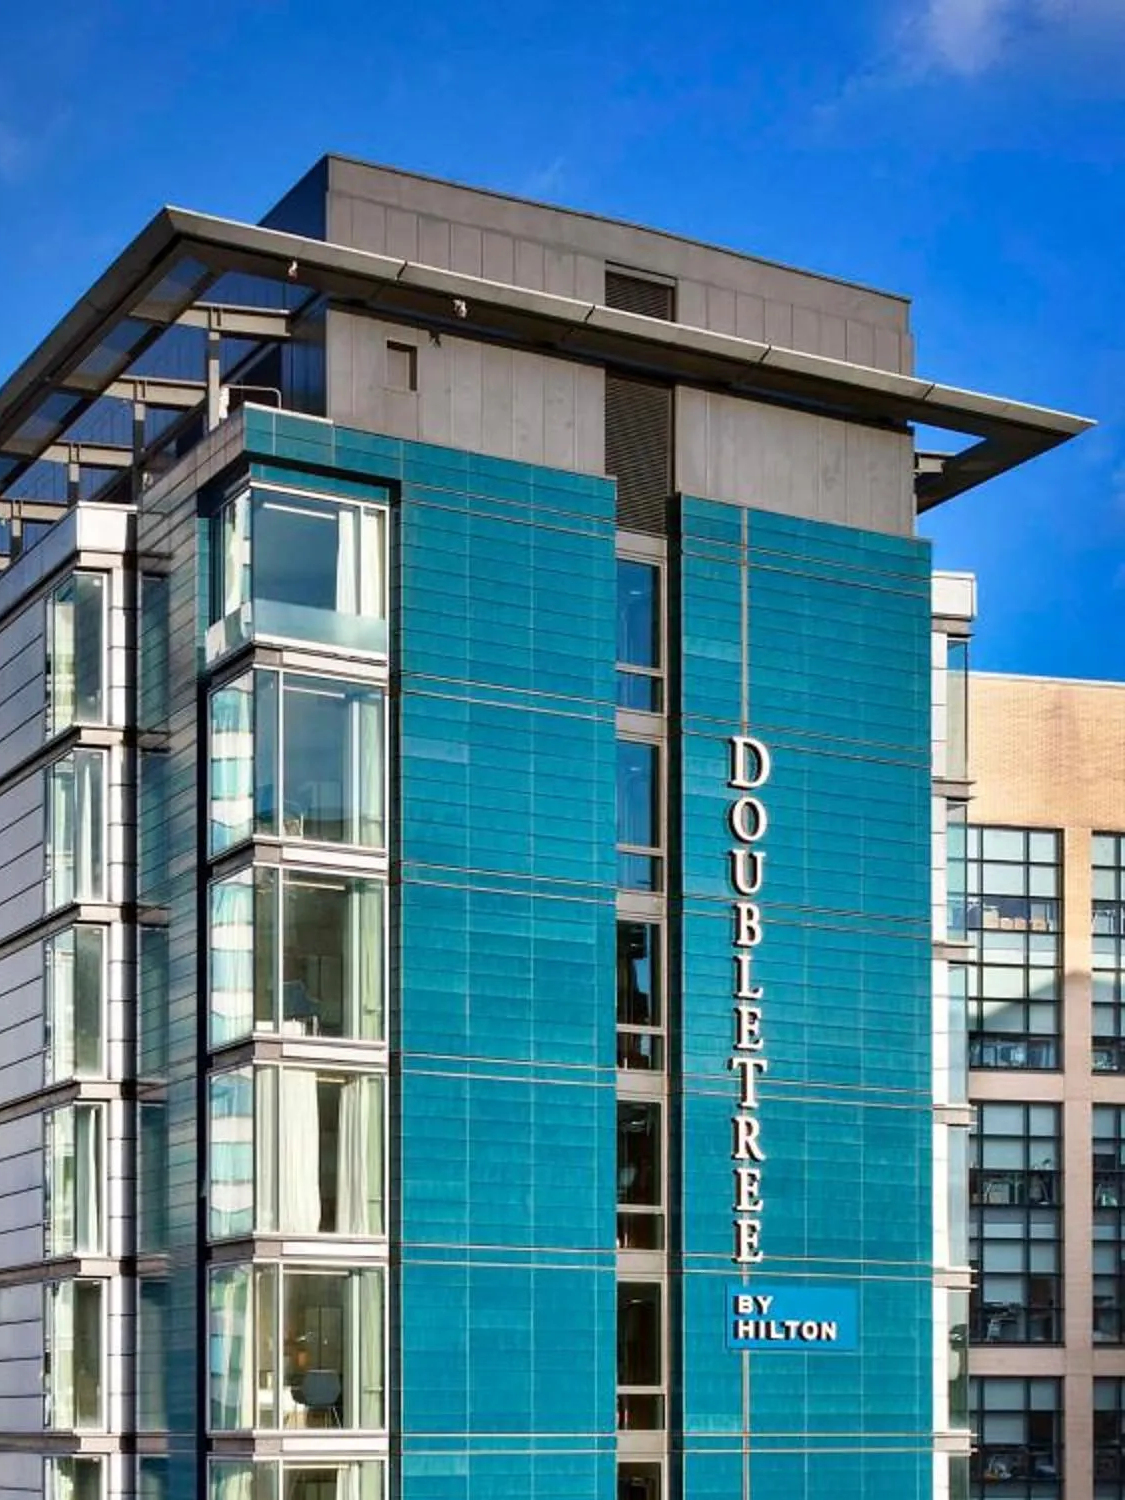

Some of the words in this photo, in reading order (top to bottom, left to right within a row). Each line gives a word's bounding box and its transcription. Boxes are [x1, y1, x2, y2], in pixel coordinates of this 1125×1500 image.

[731, 735, 770, 1263] DOUBLETREE
[737, 1295, 773, 1315] BY
[737, 1319, 837, 1341] HILTON
